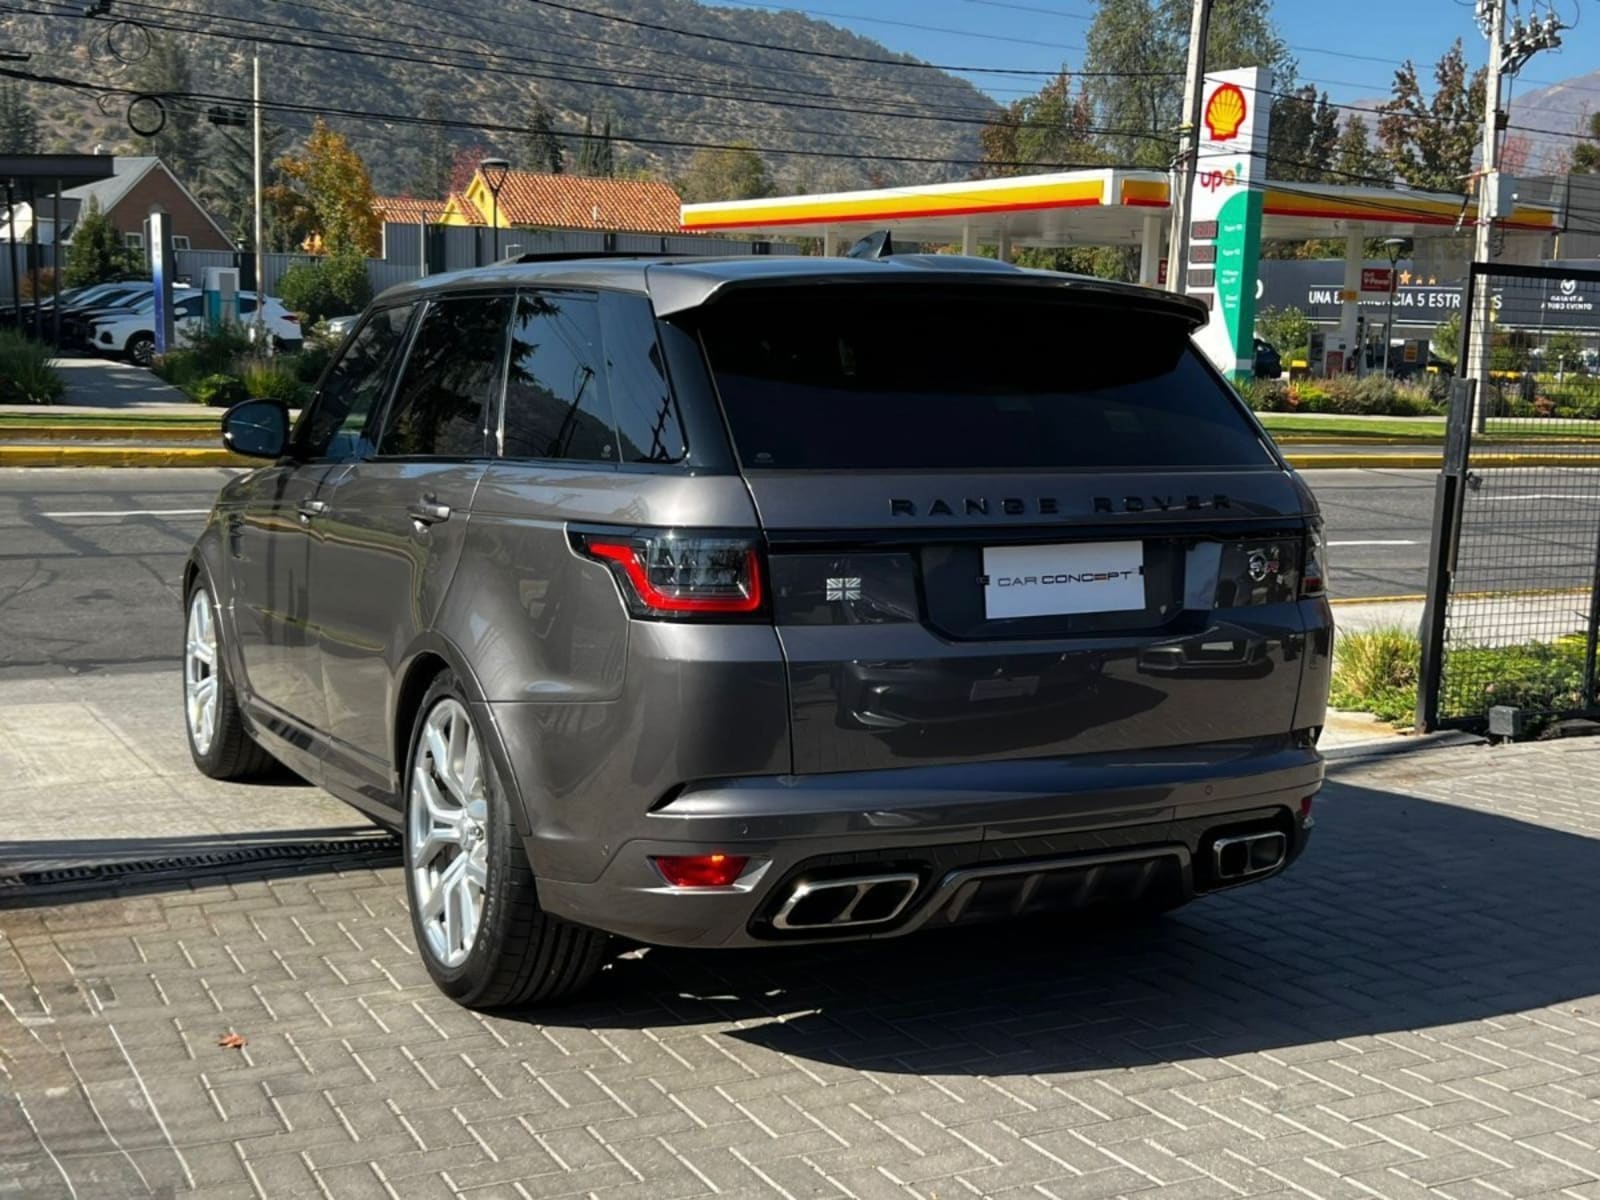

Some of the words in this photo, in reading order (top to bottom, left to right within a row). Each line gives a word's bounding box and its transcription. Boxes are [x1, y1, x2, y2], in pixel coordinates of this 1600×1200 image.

[1308, 290, 1332, 305] UNA
[1416, 292, 1426, 308] 5
[888, 498, 1059, 516] RANGE
[1092, 494, 1231, 513] ROVER
[998, 576, 1038, 588] CAR
[1041, 570, 1133, 585] CONCEPT
